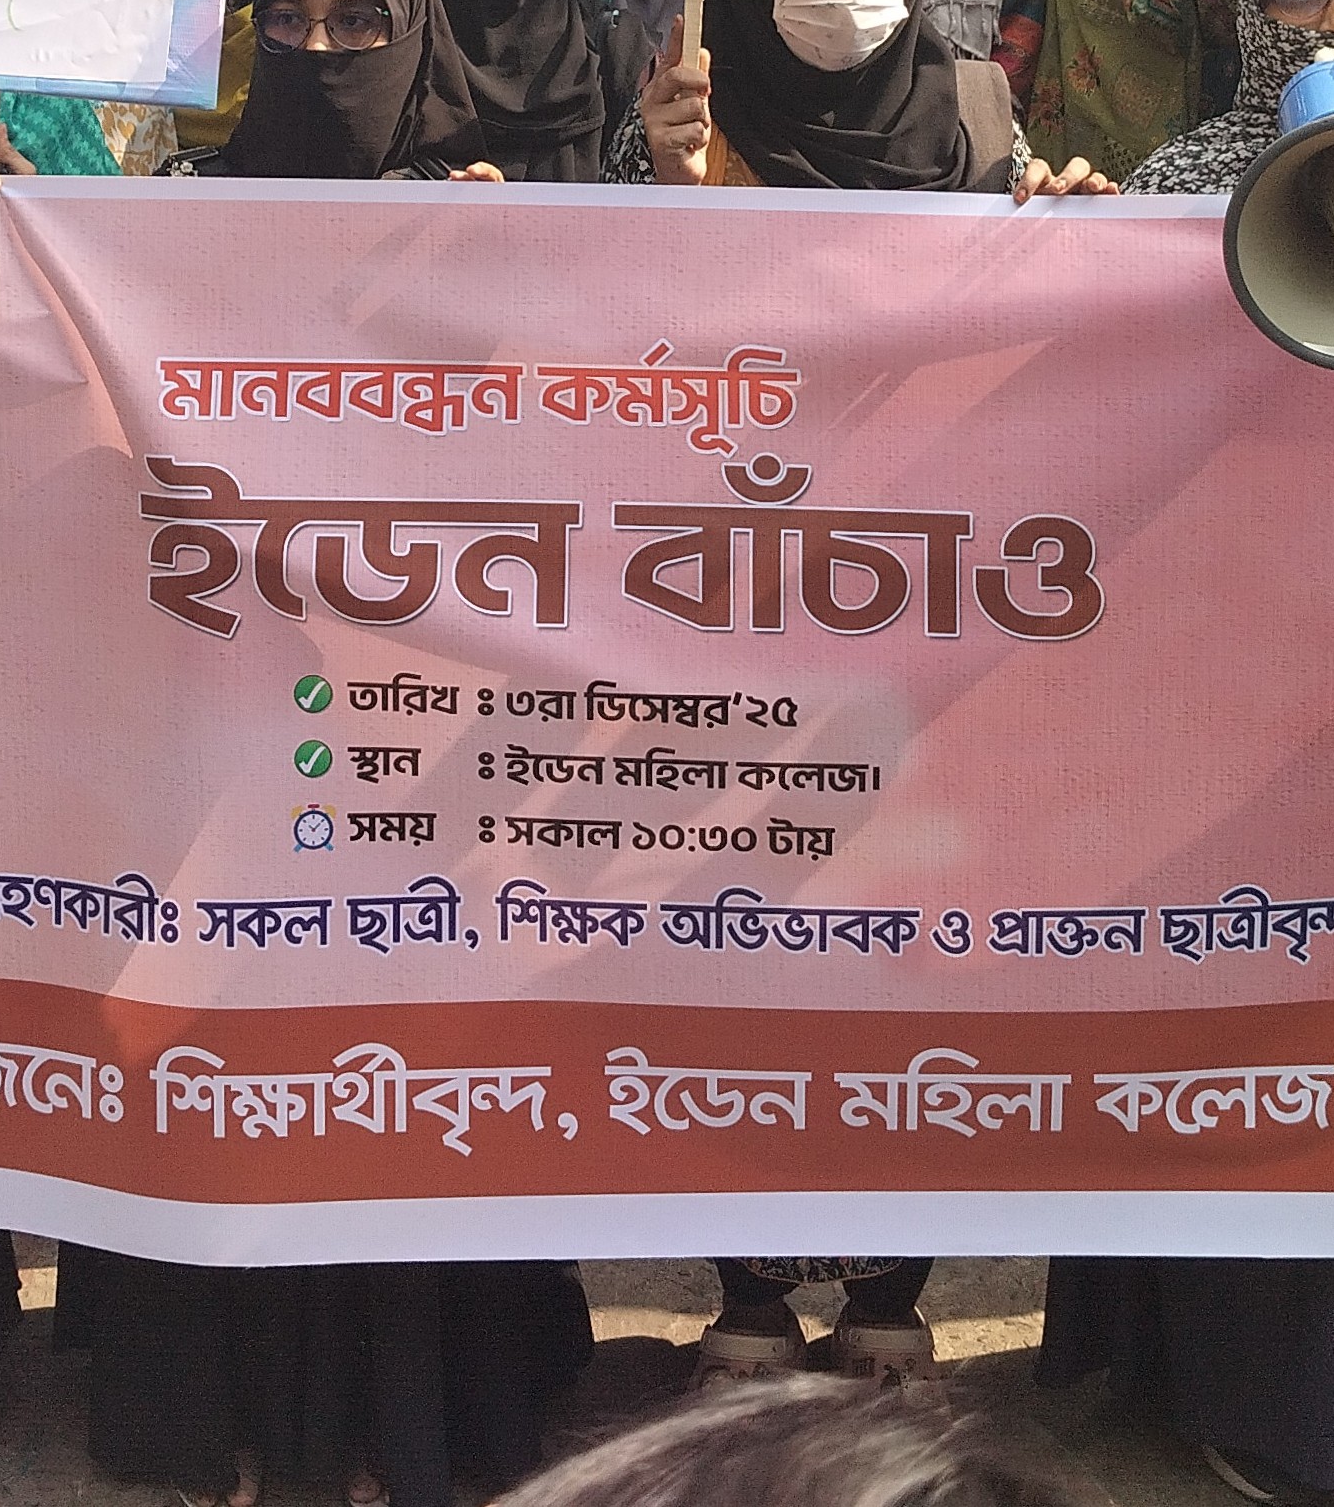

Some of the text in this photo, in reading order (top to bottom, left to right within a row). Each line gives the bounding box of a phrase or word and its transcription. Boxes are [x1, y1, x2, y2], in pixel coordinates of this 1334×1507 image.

[158, 341, 800, 454] মানববন্ধন কর্মসূচি
[141, 453, 1104, 640] ইডেন বাঁচাও
[348, 674, 458, 715] তারিখ
[505, 690, 576, 721] ৩রা
[348, 746, 420, 783] স্থান
[505, 744, 605, 785] ইডেন
[613, 748, 727, 791] মহিলা
[349, 812, 436, 843] সময়
[505, 816, 621, 851] সকাল
[630, 823, 757, 851] ১০:৩০
[766, 817, 835, 861] টায়
[198, 895, 331, 949] সকল
[346, 876, 479, 953] ছাত্রী,
[496, 881, 648, 946] শিক্ষক
[660, 890, 921, 955] অভিভাবক
[930, 907, 972, 955] ও
[990, 899, 1144, 956] প্রাক্তন
[149, 1041, 579, 1155] শিক্ষার্থীবৃন্দ,
[606, 1047, 811, 1133] ইডেন
[835, 1048, 1071, 1137] মহিলা
